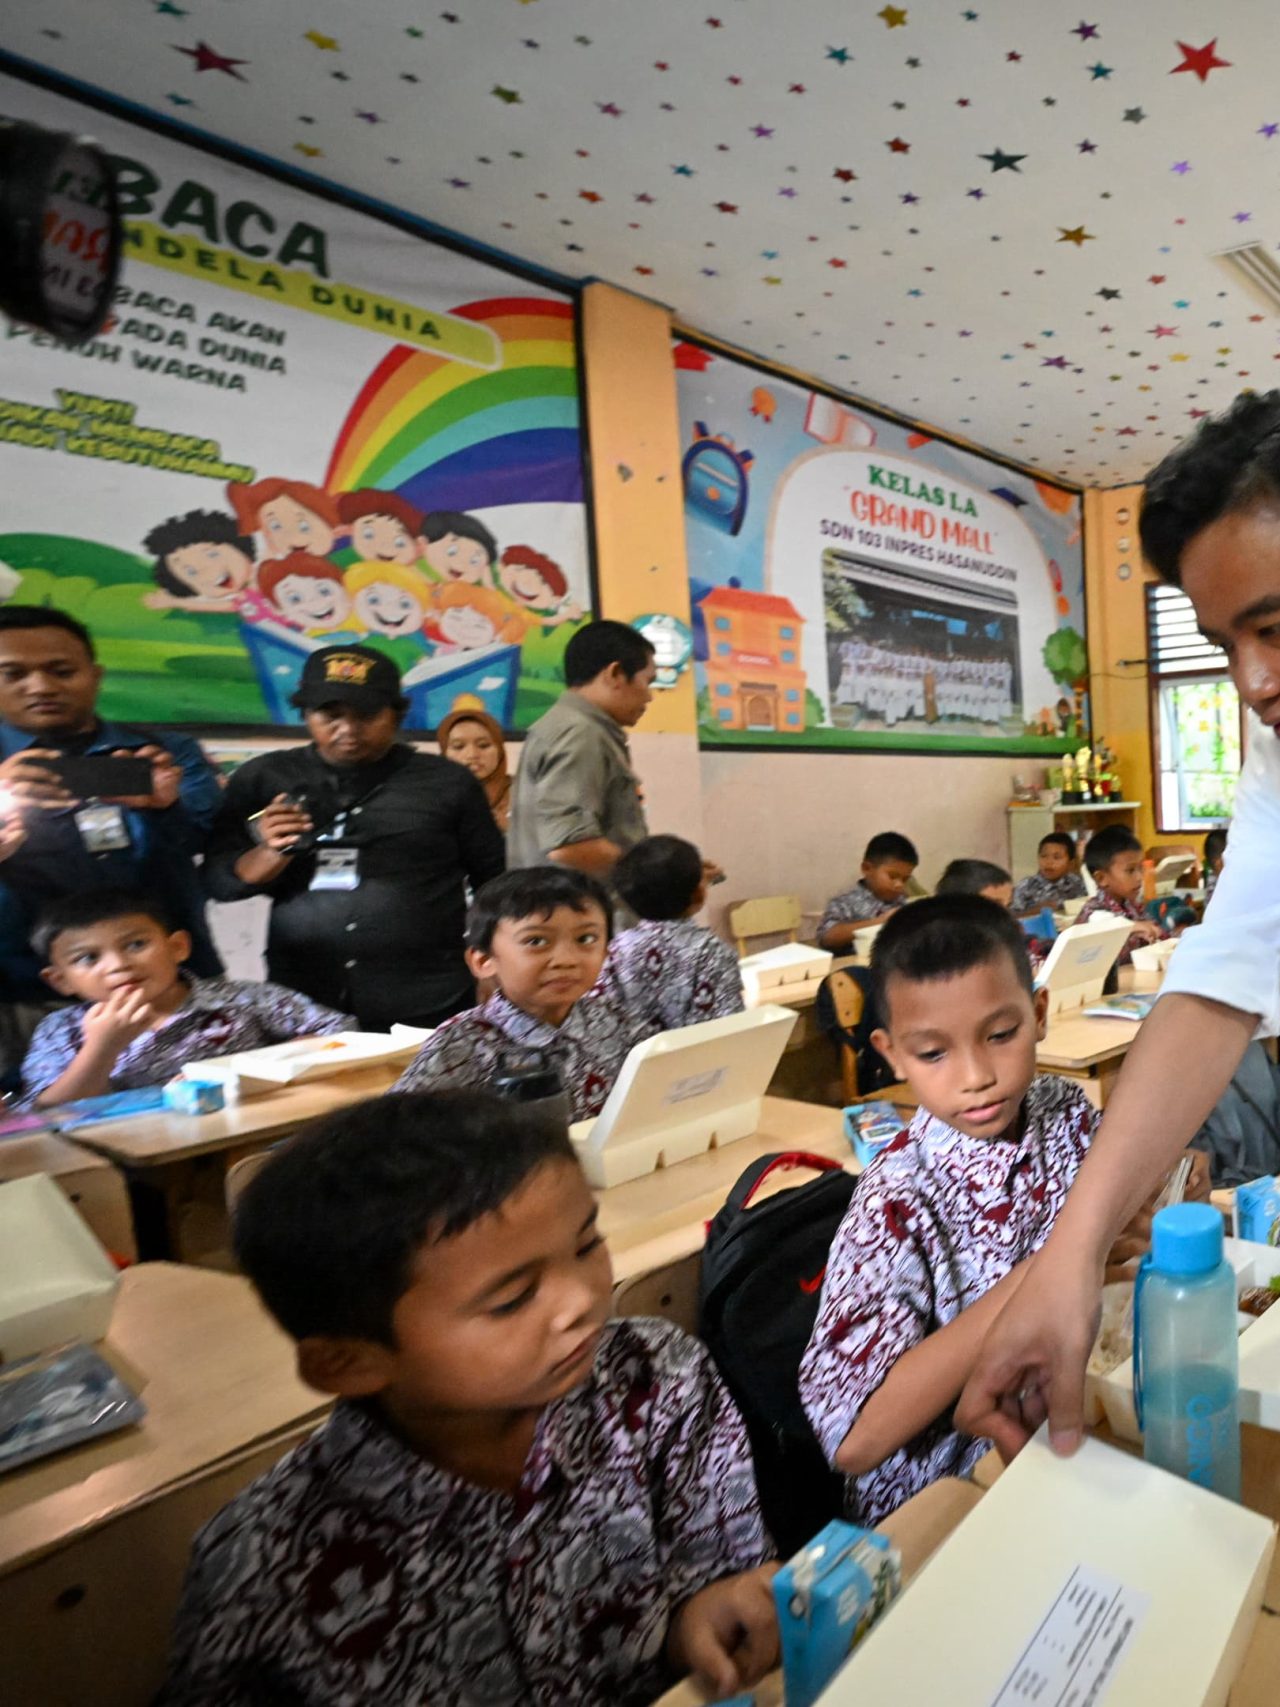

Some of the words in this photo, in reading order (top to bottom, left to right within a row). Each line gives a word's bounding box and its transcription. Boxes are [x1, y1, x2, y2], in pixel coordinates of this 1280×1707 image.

[117, 228, 286, 293] NDELA
[310, 284, 442, 340] DUNIA
[110, 285, 197, 323] BACA
[207, 310, 287, 347] AKAN
[130, 349, 247, 394] WARNA
[198, 336, 288, 376] DUNIA
[867, 463, 946, 507] KELAS
[820, 518, 855, 542] SDN
[857, 529, 882, 548] 103
[884, 535, 935, 562] INPRES
[936, 551, 1018, 583] HASANUDDIN
